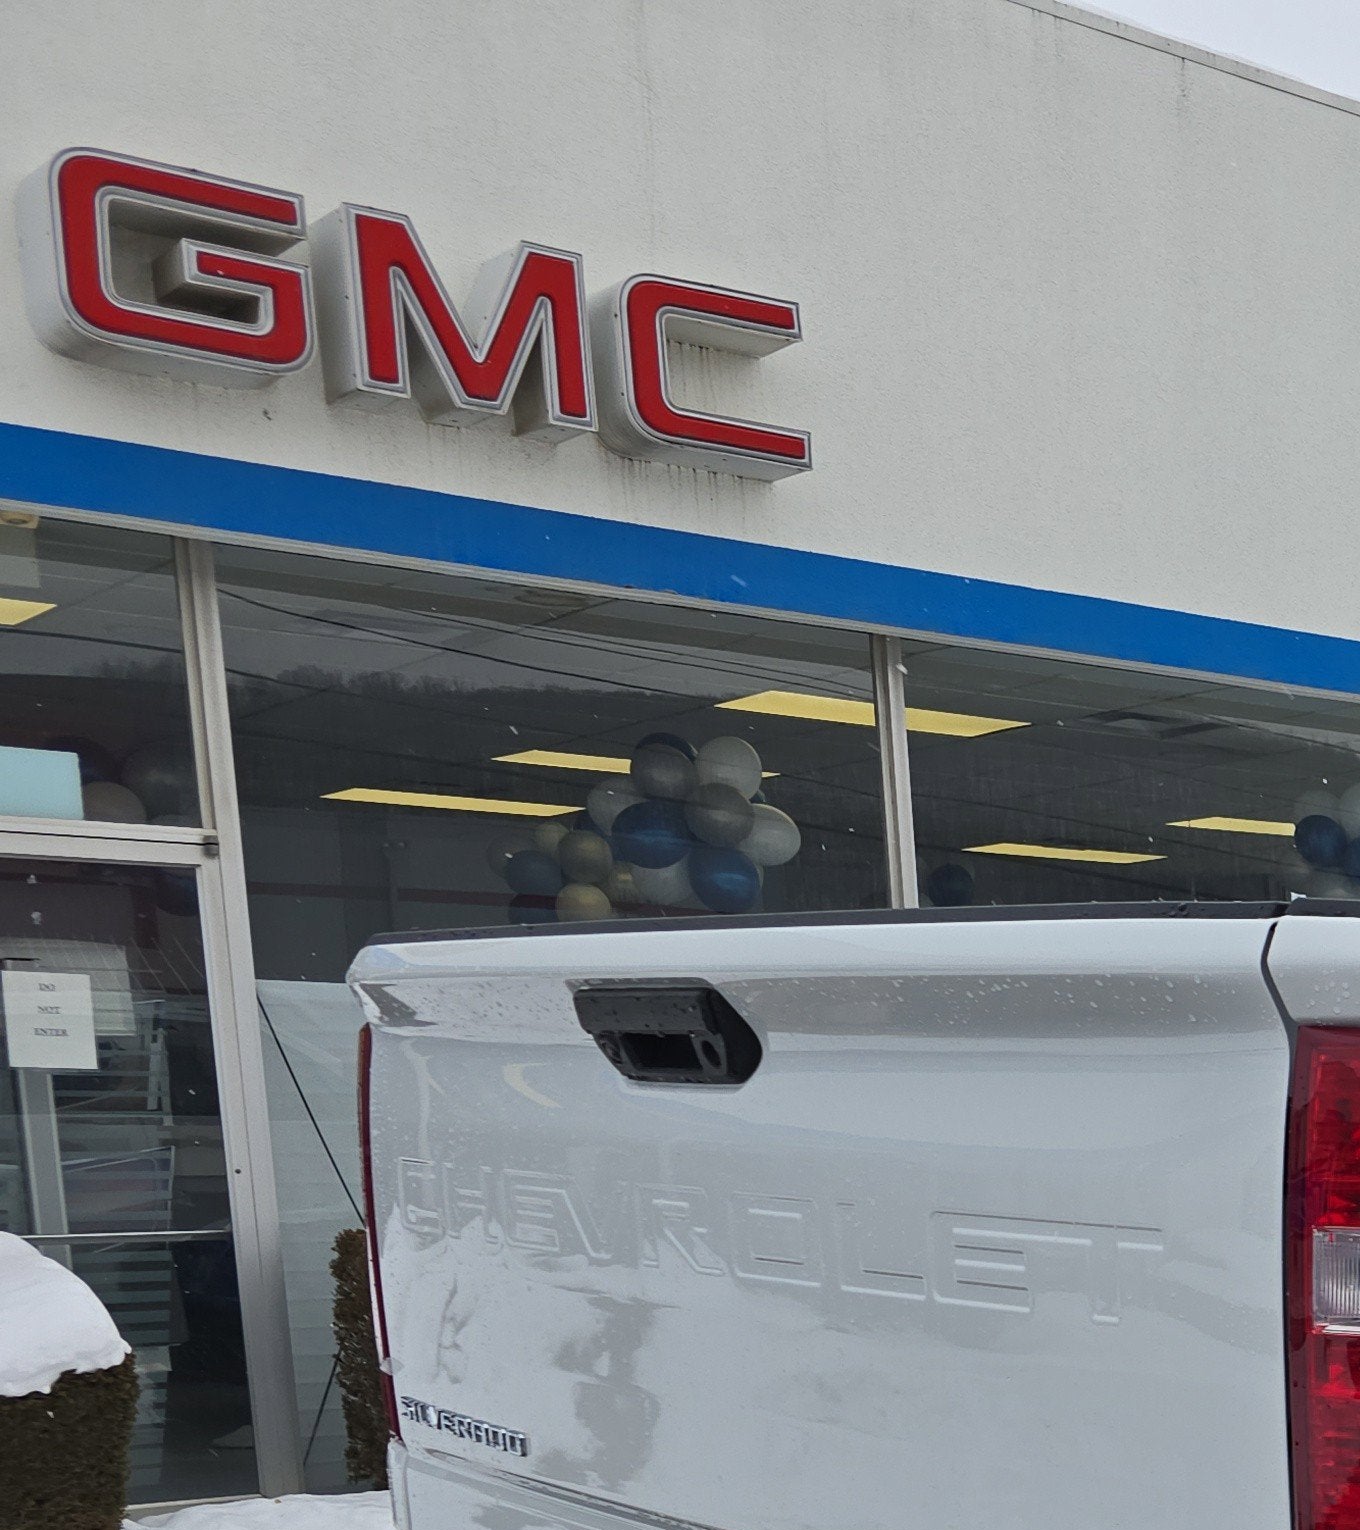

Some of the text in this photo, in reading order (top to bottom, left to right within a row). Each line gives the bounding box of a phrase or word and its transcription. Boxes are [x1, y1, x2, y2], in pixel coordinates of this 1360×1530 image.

[44, 146, 813, 474] GMC
[398, 1155, 1164, 1324] CHEVROLET
[400, 1395, 530, 1457] SILVERADO
